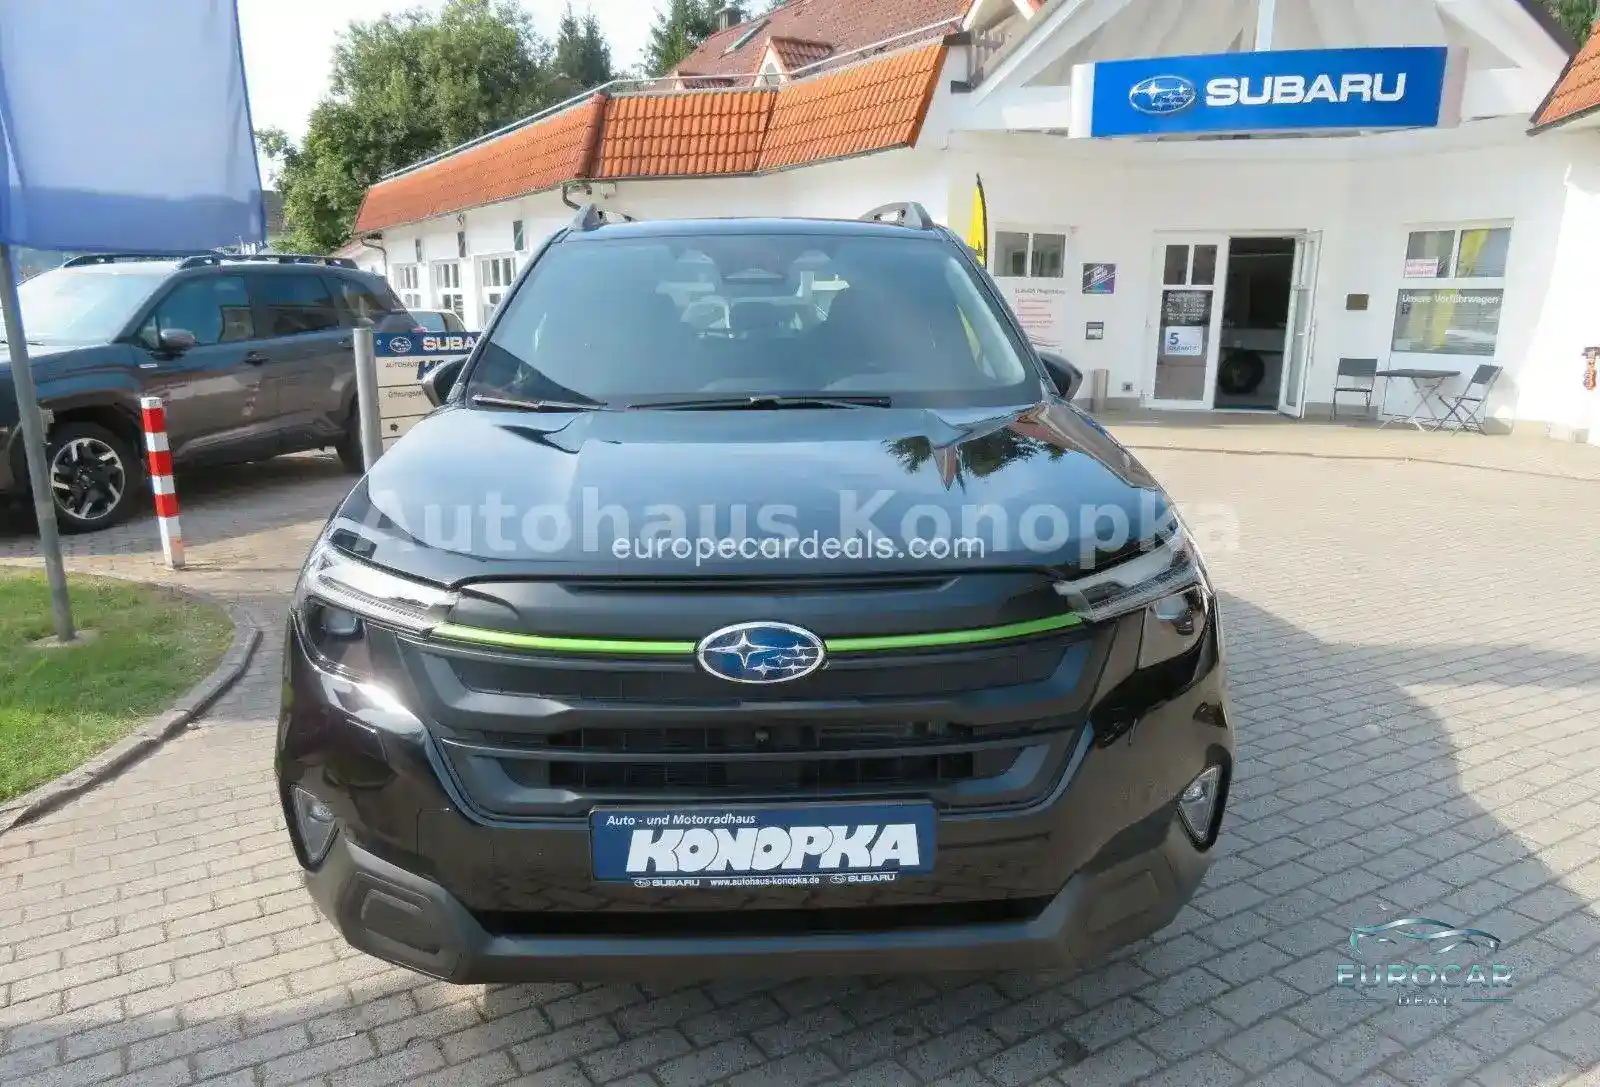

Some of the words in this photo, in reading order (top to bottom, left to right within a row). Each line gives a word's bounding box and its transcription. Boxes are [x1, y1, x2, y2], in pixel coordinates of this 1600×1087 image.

[1206, 72, 1407, 106] SUBARU
[422, 336, 476, 351] SUBA
[1169, 332, 1180, 345] 5
[388, 389, 427, 399] Öffnungszei
[606, 815, 635, 826] Auto
[647, 814, 669, 825] und
[673, 813, 756, 825] Motorradhaus
[626, 823, 920, 872] KONOPKA
[652, 879, 700, 887] SUBARU
[710, 876, 820, 887] www.autohaus-konopka.de
[847, 874, 895, 882] SUBARU
